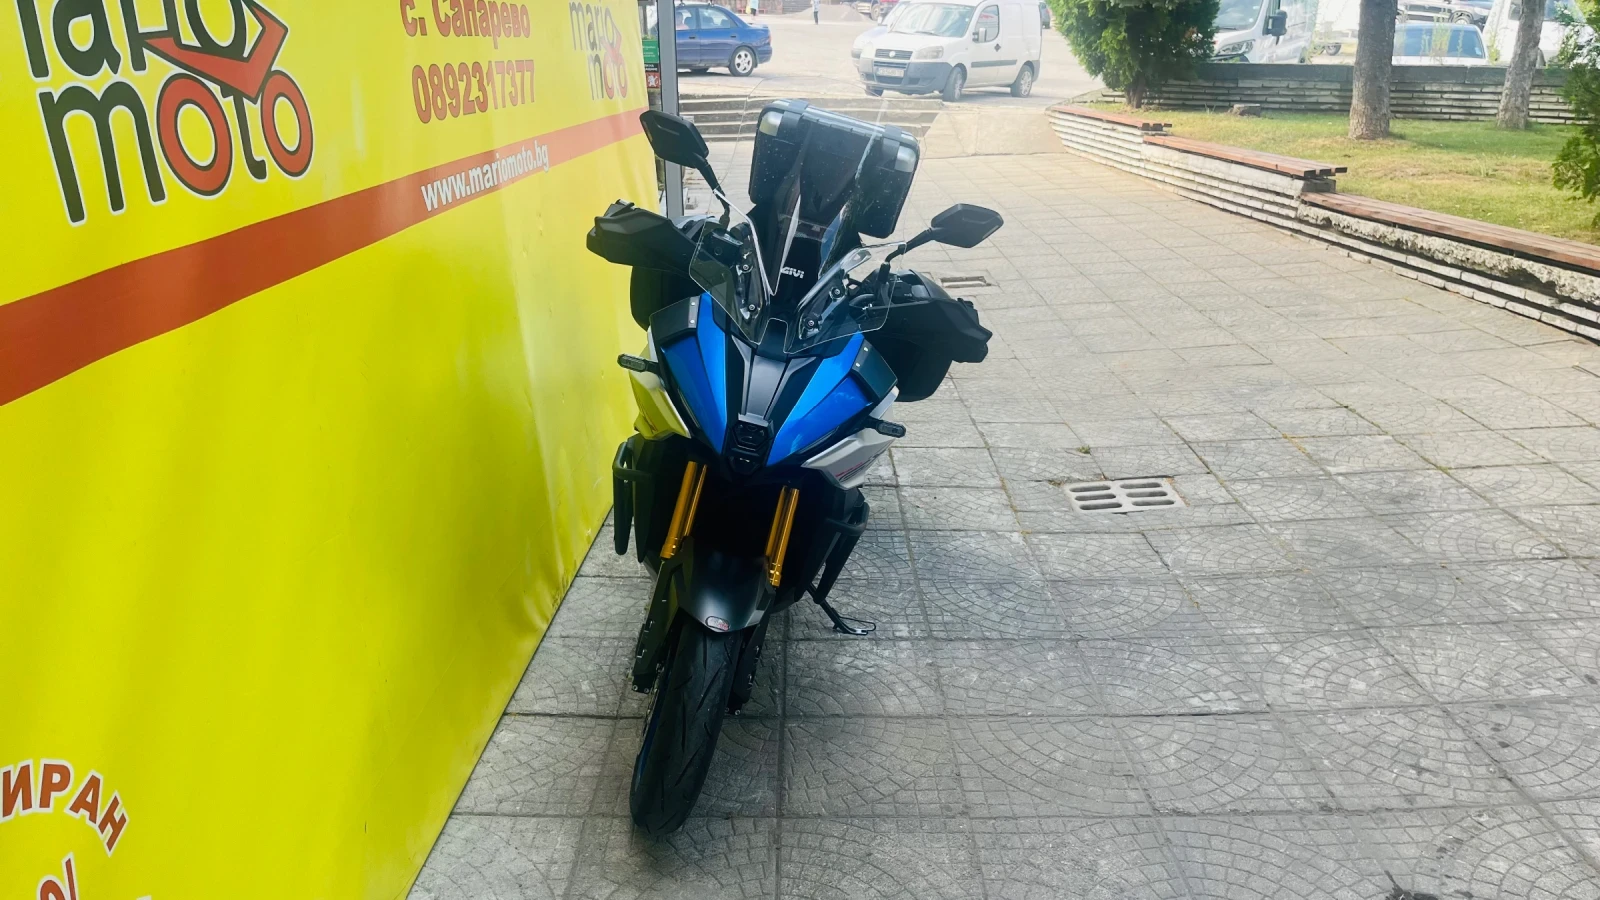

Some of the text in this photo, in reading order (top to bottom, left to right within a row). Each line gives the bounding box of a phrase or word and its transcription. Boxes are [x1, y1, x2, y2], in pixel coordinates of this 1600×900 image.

[568, 1, 616, 51] mario
[411, 59, 535, 124] 0892317377
[38, 69, 313, 225] moto
[420, 139, 549, 212] www.mariomoto.bg
[1, 761, 128, 854] ИРАН
